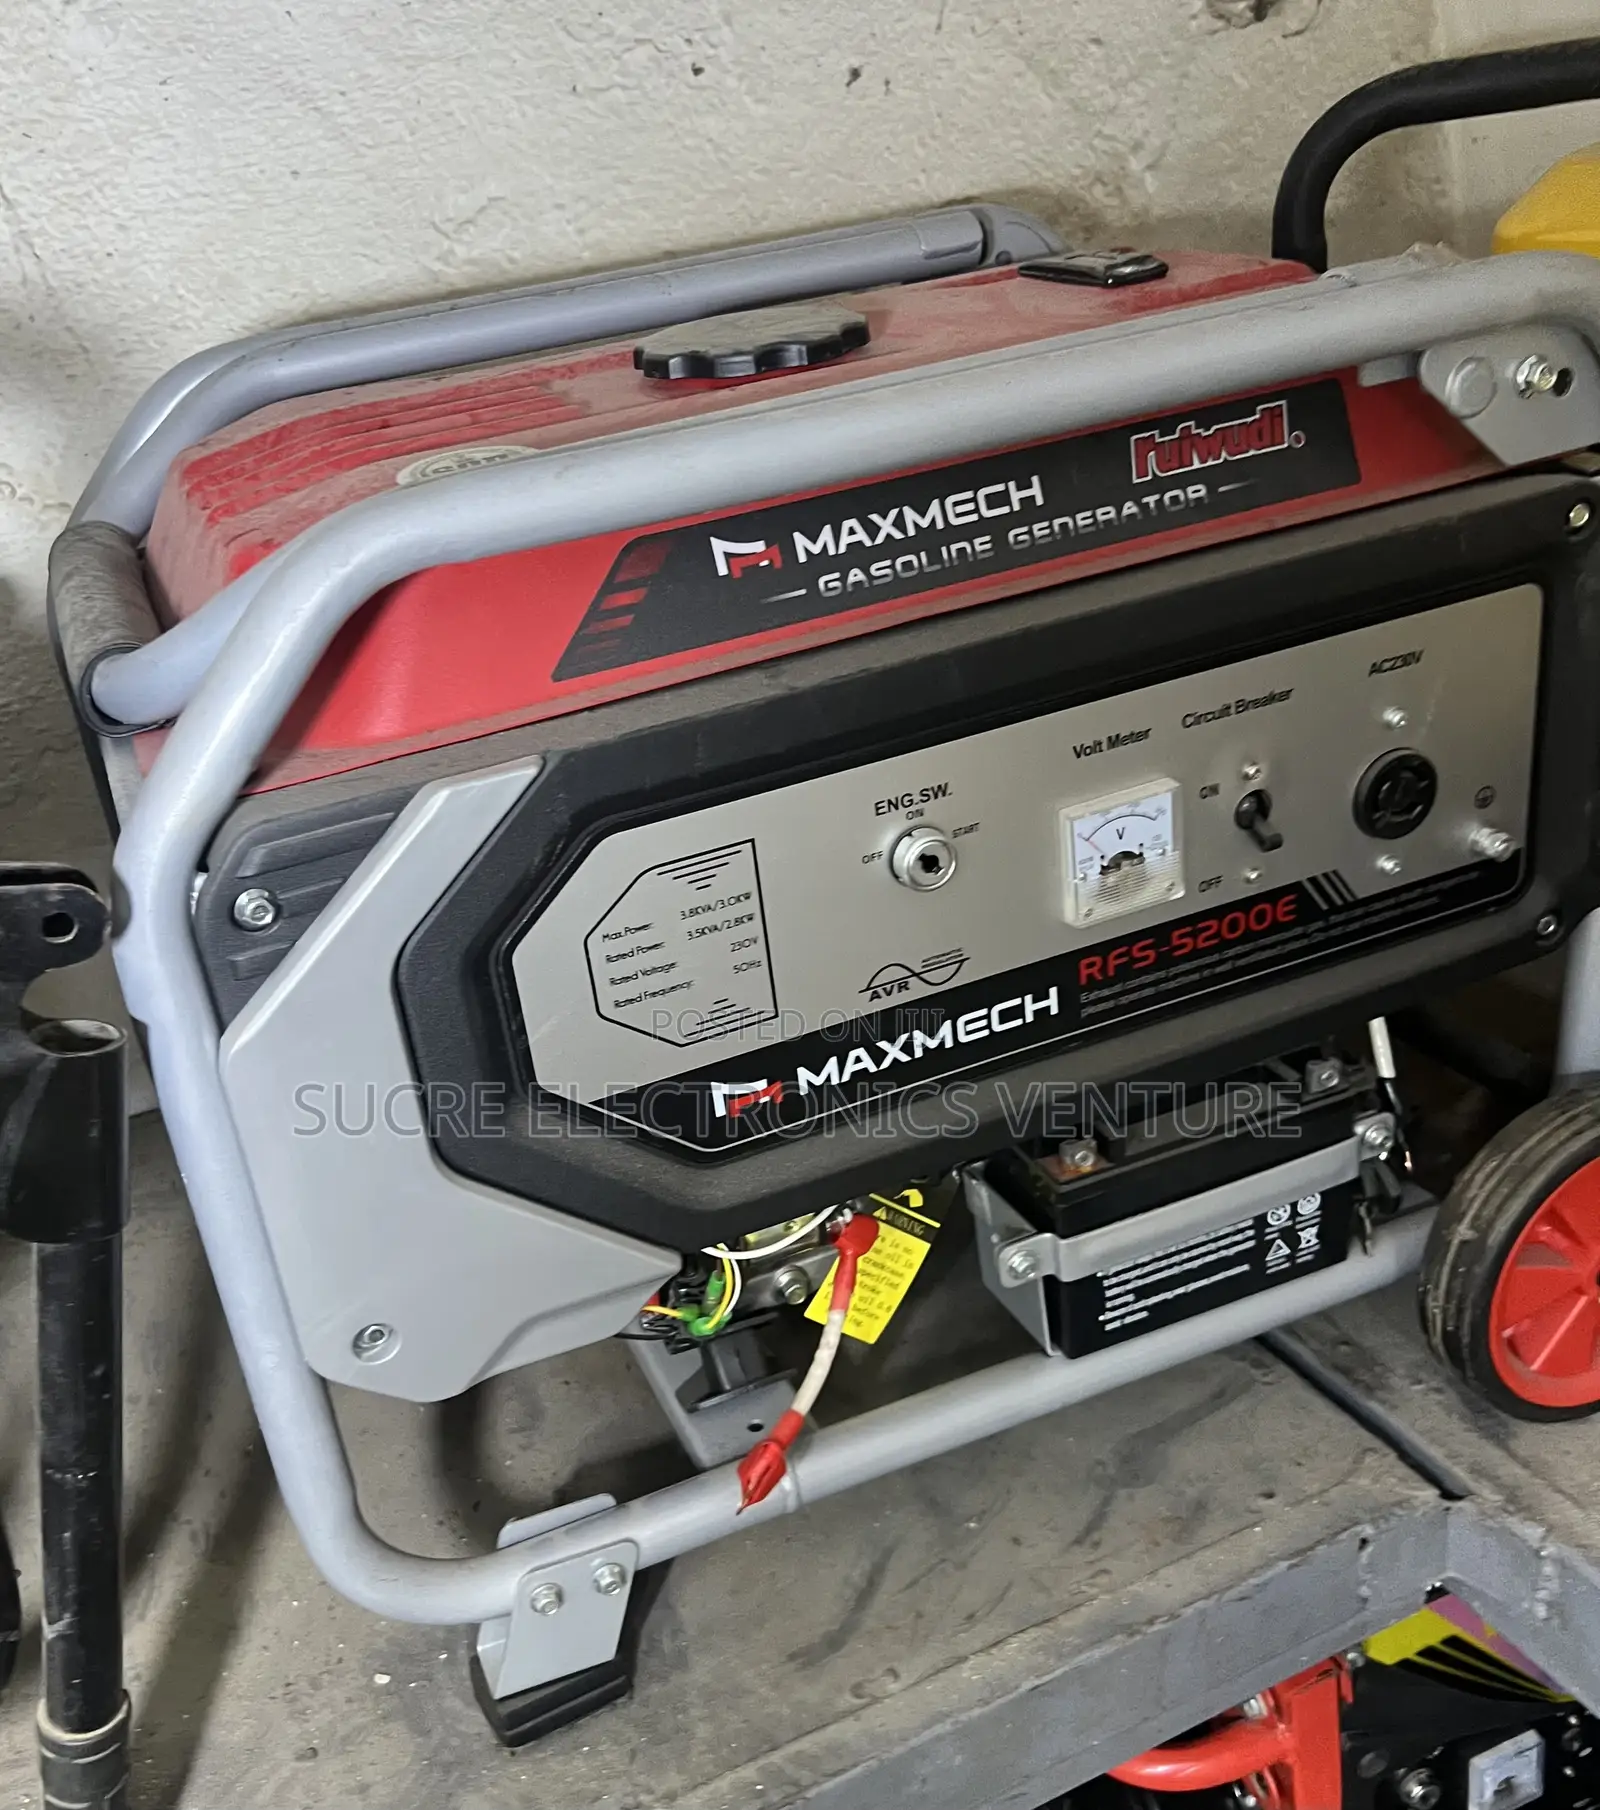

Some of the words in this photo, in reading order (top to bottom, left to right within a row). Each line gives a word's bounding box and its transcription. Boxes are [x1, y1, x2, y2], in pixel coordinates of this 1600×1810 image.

[792, 475, 1044, 563] MAXMECH
[818, 535, 994, 598] GASOLINE
[1007, 484, 1209, 550] GENERATOR
[1368, 649, 1426, 677] AC230V
[1181, 703, 1232, 729] Circuit
[1234, 688, 1295, 714] Breaker
[1072, 739, 1104, 759] Volt
[1106, 727, 1153, 751] Meter
[874, 782, 953, 816] ENG.SW.
[905, 808, 925, 820] ON
[952, 822, 980, 839] START
[1116, 826, 1126, 840] V
[861, 850, 884, 864] OFF
[1198, 875, 1224, 893] OFF
[605, 947, 635, 964] Rated
[1078, 894, 1298, 986] RFS-5200E
[609, 971, 639, 986] Rated
[730, 936, 760, 953] 230V
[613, 993, 643, 1008] Rated
[733, 960, 763, 974] 50Hz
[868, 980, 911, 1002] AVR
[796, 986, 1059, 1096] MAXMECH
